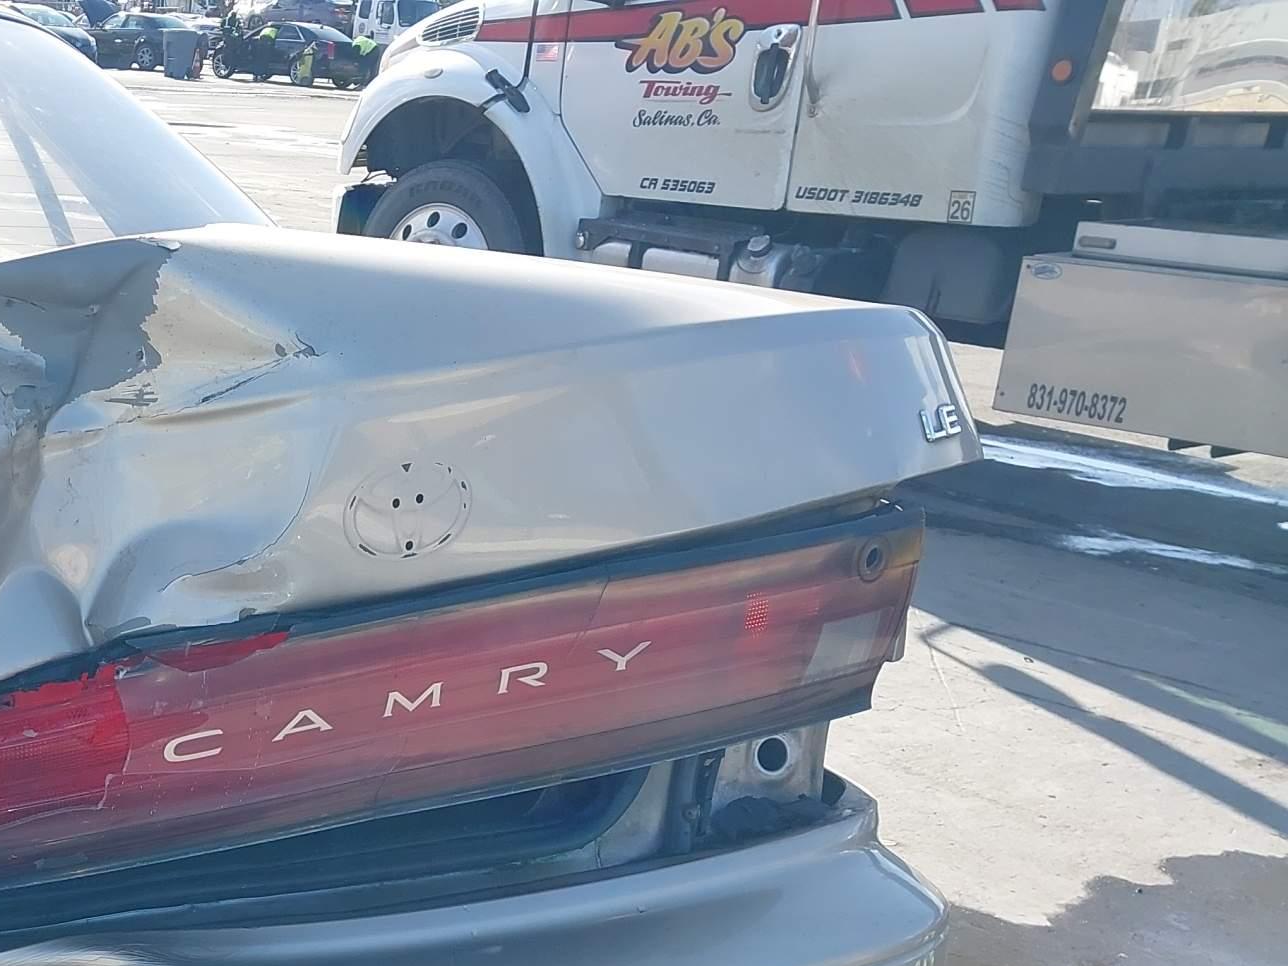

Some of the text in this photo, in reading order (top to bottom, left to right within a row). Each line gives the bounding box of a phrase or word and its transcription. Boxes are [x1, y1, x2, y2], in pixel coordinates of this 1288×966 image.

[616, 7, 745, 74] AB'S
[640, 80, 732, 105] Towing
[639, 177, 716, 194] CA 535063
[795, 186, 923, 207] USDOT 3186348
[950, 200, 971, 220] 26
[1027, 383, 1127, 424] 831-970-8372
[918, 403, 962, 443] LE
[163, 640, 652, 763] CAMRY
